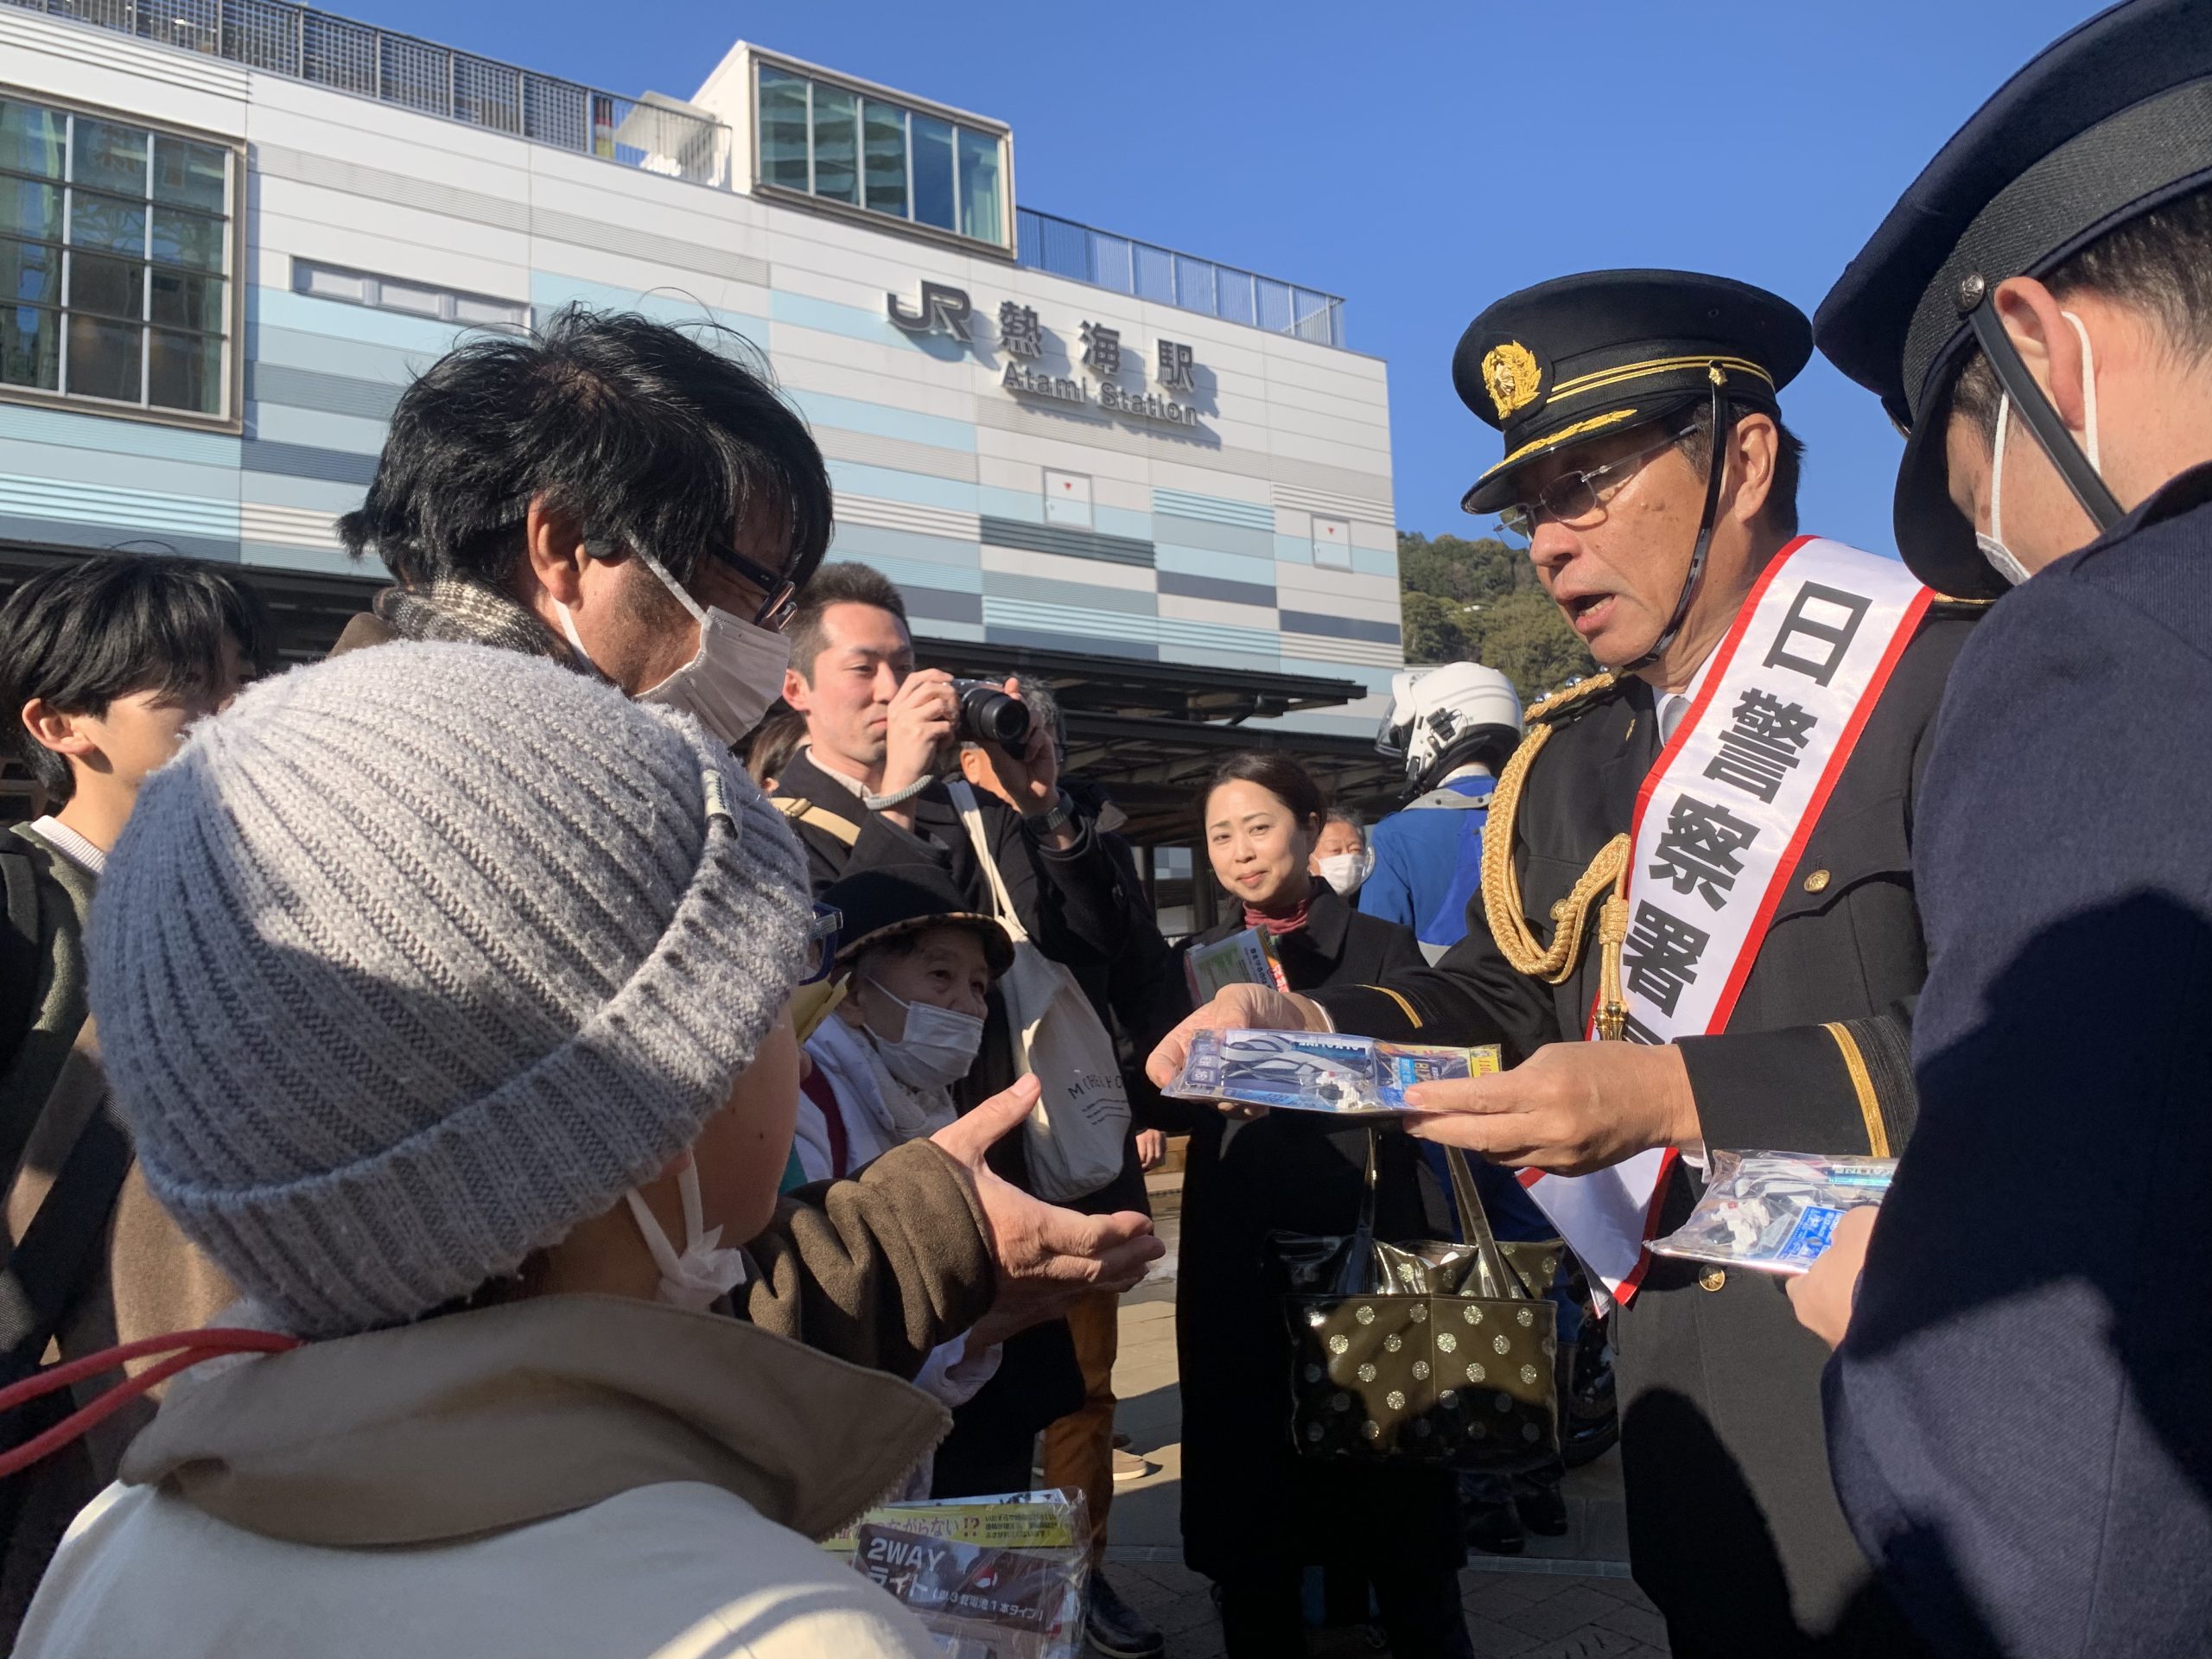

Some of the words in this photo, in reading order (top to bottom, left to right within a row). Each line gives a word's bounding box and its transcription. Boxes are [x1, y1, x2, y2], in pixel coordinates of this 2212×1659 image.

[885, 279, 973, 343] JR
[998, 301, 1195, 393] 熱海駅
[1001, 361, 1086, 404] Atami
[1097, 381, 1198, 427] Station
[867, 1537, 946, 1572] 2WAY
